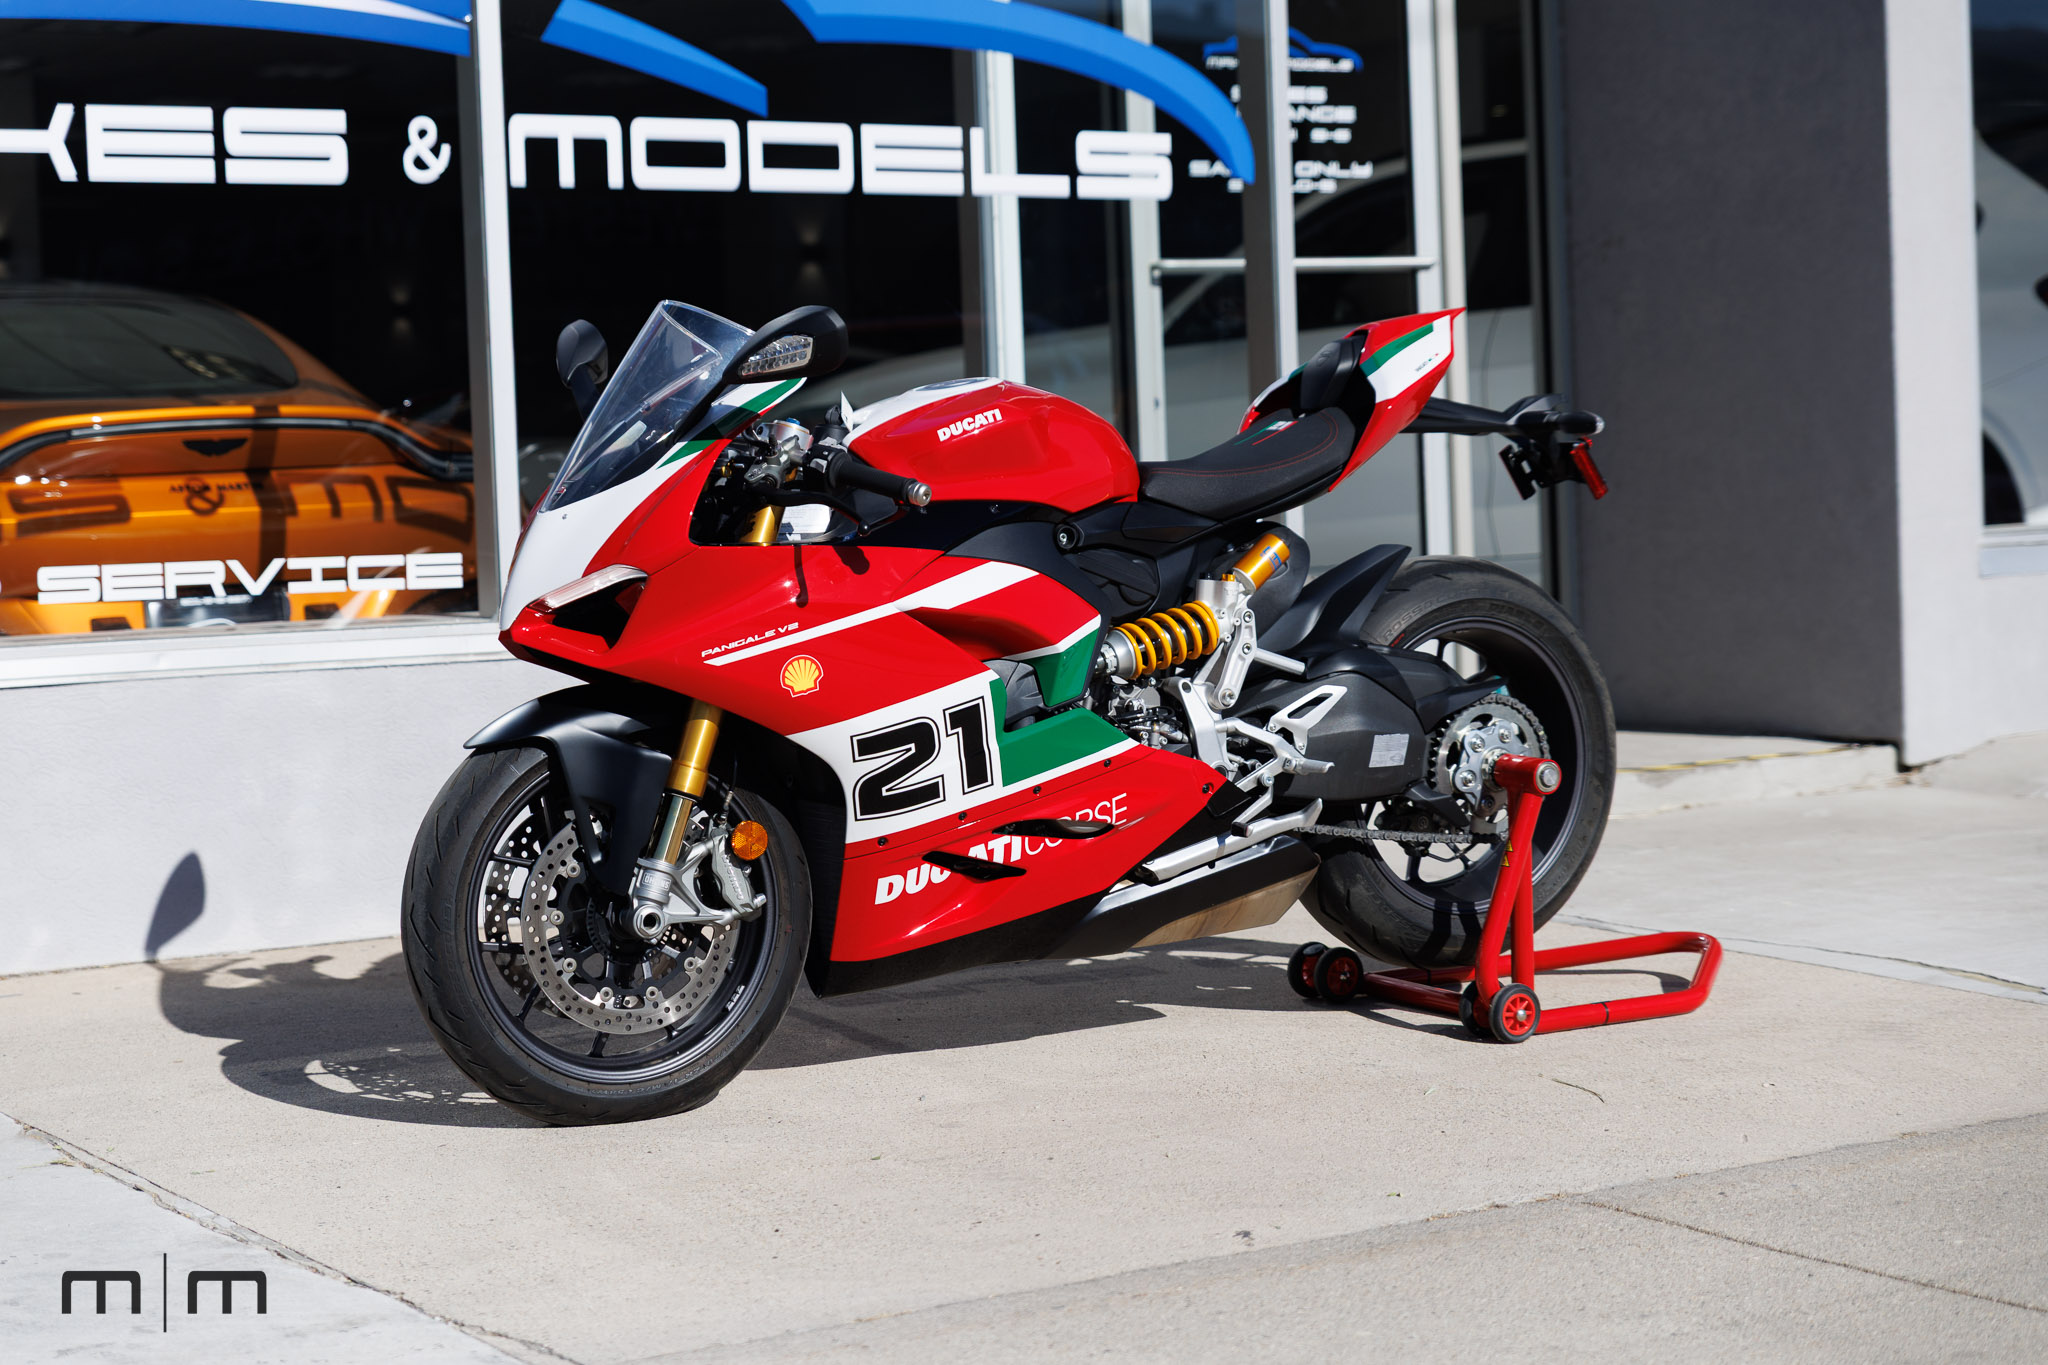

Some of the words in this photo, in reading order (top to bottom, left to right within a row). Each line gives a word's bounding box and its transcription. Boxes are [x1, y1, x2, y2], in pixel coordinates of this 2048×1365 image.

[402, 115, 452, 184] &
[508, 113, 1173, 201] MODELS
[937, 408, 1003, 442] DUCATI
[37, 552, 464, 605] SERVICE
[701, 629, 777, 658] PANIGALE
[777, 622, 800, 634] V2
[850, 696, 994, 821] 21
